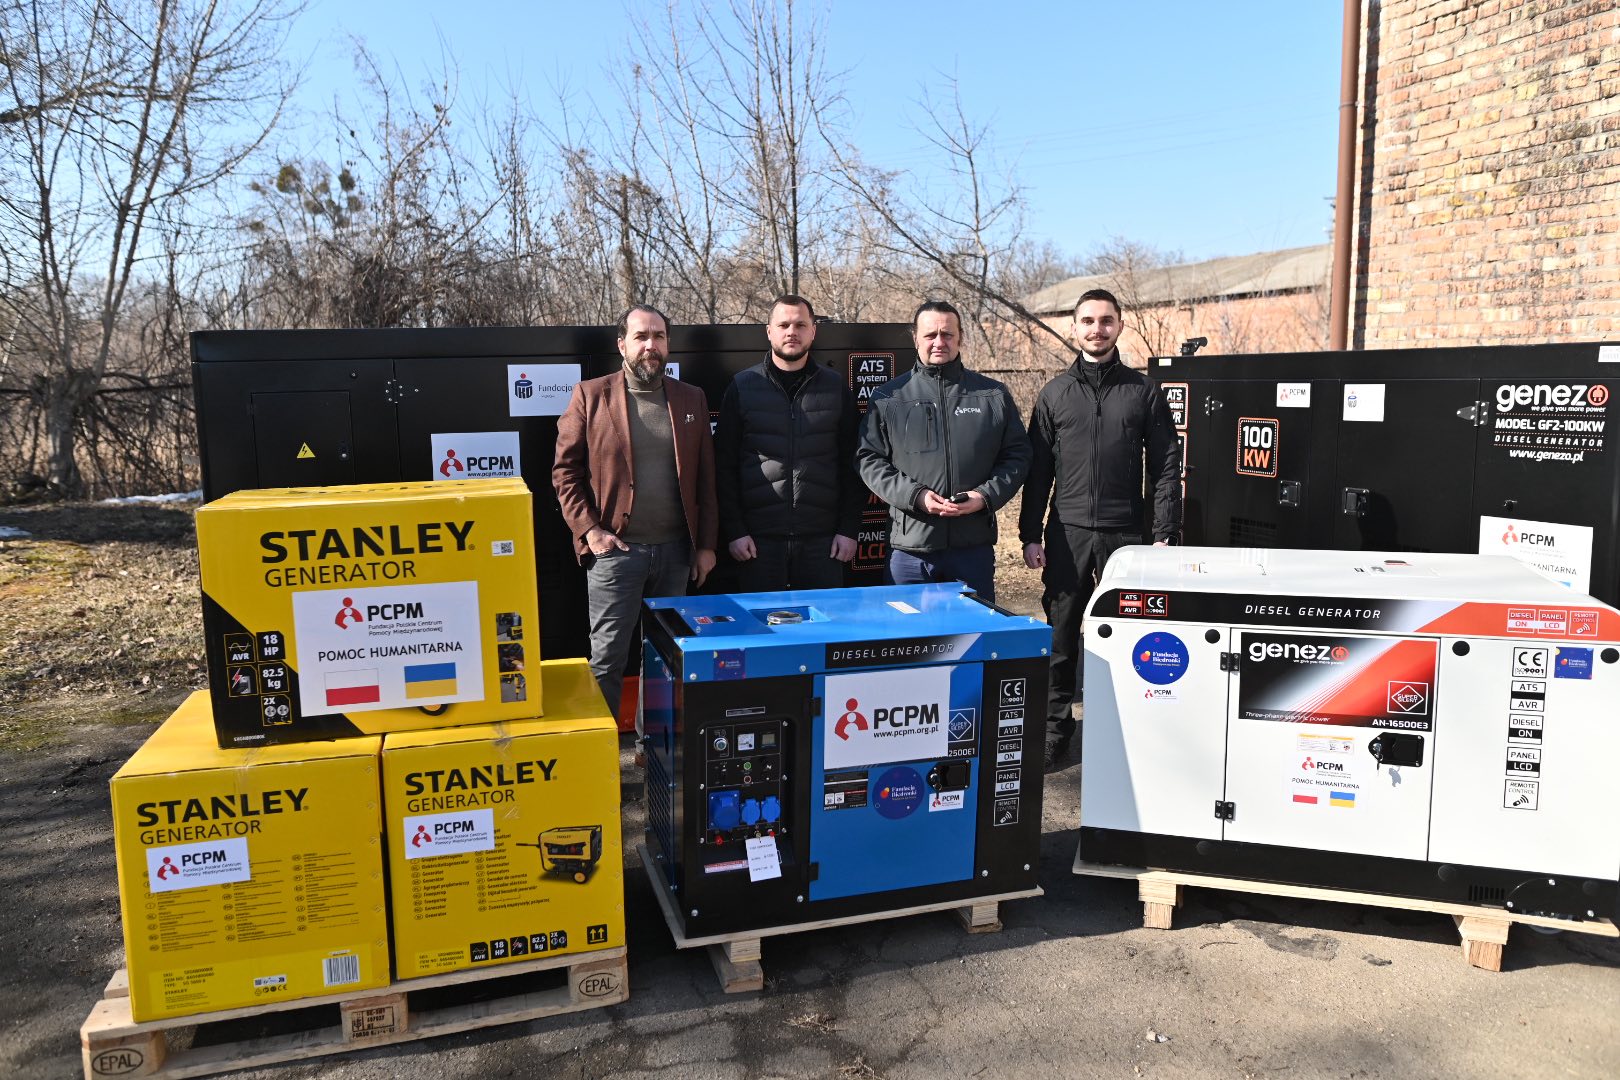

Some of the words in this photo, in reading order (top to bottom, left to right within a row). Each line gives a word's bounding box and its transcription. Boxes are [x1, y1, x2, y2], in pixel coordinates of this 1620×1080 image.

[860, 360, 884, 372] ATS
[857, 375, 887, 385] system
[538, 384, 572, 393] Fundacja
[858, 386, 879, 399] AV
[1289, 388, 1306, 396] PCPM
[1167, 389, 1182, 401] ATS
[1541, 405, 1554, 413] give
[1172, 411, 1182, 423] VR
[1495, 418, 1536, 430] MODEL:
[1538, 419, 1605, 433] GF2-100KW
[1243, 425, 1273, 449] 100
[1494, 435, 1531, 444] DIESEL
[1536, 437, 1603, 447] GENERATOR
[1243, 448, 1271, 469] KW
[1509, 449, 1584, 464] www.genezo.pl
[467, 456, 514, 471] PCPM
[259, 520, 475, 564] STANLEY
[858, 531, 885, 542] PANE
[1521, 532, 1555, 547] PCPM
[264, 560, 416, 588] GENERATOR
[1529, 561, 1577, 575] ANITARNA
[1148, 597, 1164, 608] CE
[367, 602, 424, 621] PCPM
[1245, 605, 1291, 616] DIESEL
[1298, 607, 1381, 619] GENERATOR
[263, 634, 278, 644] 18
[232, 653, 249, 661] AVR
[264, 647, 279, 656] HP
[318, 648, 365, 663] POMOC
[370, 641, 463, 658] HUMANITARNA
[833, 650, 876, 660] DIESEL
[881, 644, 954, 657] GENERATOR
[1518, 651, 1542, 667] CE
[263, 667, 284, 677] 82.5
[267, 679, 281, 689] kg
[1004, 682, 1021, 696] CE
[1519, 683, 1538, 691] ATS
[263, 697, 275, 705] 2X
[1518, 701, 1538, 709] AVR
[873, 703, 940, 730] PCPM
[1005, 711, 1018, 719] ATS
[1245, 711, 1283, 719] Three-phase
[1372, 718, 1429, 729] AN-16500E3
[1512, 718, 1540, 727] DIESEL
[873, 725, 939, 739] www.pcpm.org.pl
[1518, 729, 1533, 738] ON
[948, 748, 975, 757] 2500E1
[1000, 743, 1020, 751] DIESEL
[1511, 751, 1538, 760] PANEL
[1316, 761, 1344, 771] PCPM
[1514, 762, 1533, 771] LCD
[405, 758, 558, 796] STANLEY
[1291, 777, 1313, 785] POMOC
[1315, 780, 1360, 789] HUMANITARNA
[407, 789, 515, 813] GENERATOR
[942, 794, 960, 802] PCPM
[136, 788, 309, 828] STANLEY
[140, 820, 262, 845] GENERATOR
[434, 820, 474, 835] PCPM
[181, 850, 226, 867] PCPM
[494, 941, 504, 949] 18
[585, 976, 614, 993] EPAL
[100, 1053, 135, 1071] EPAL
